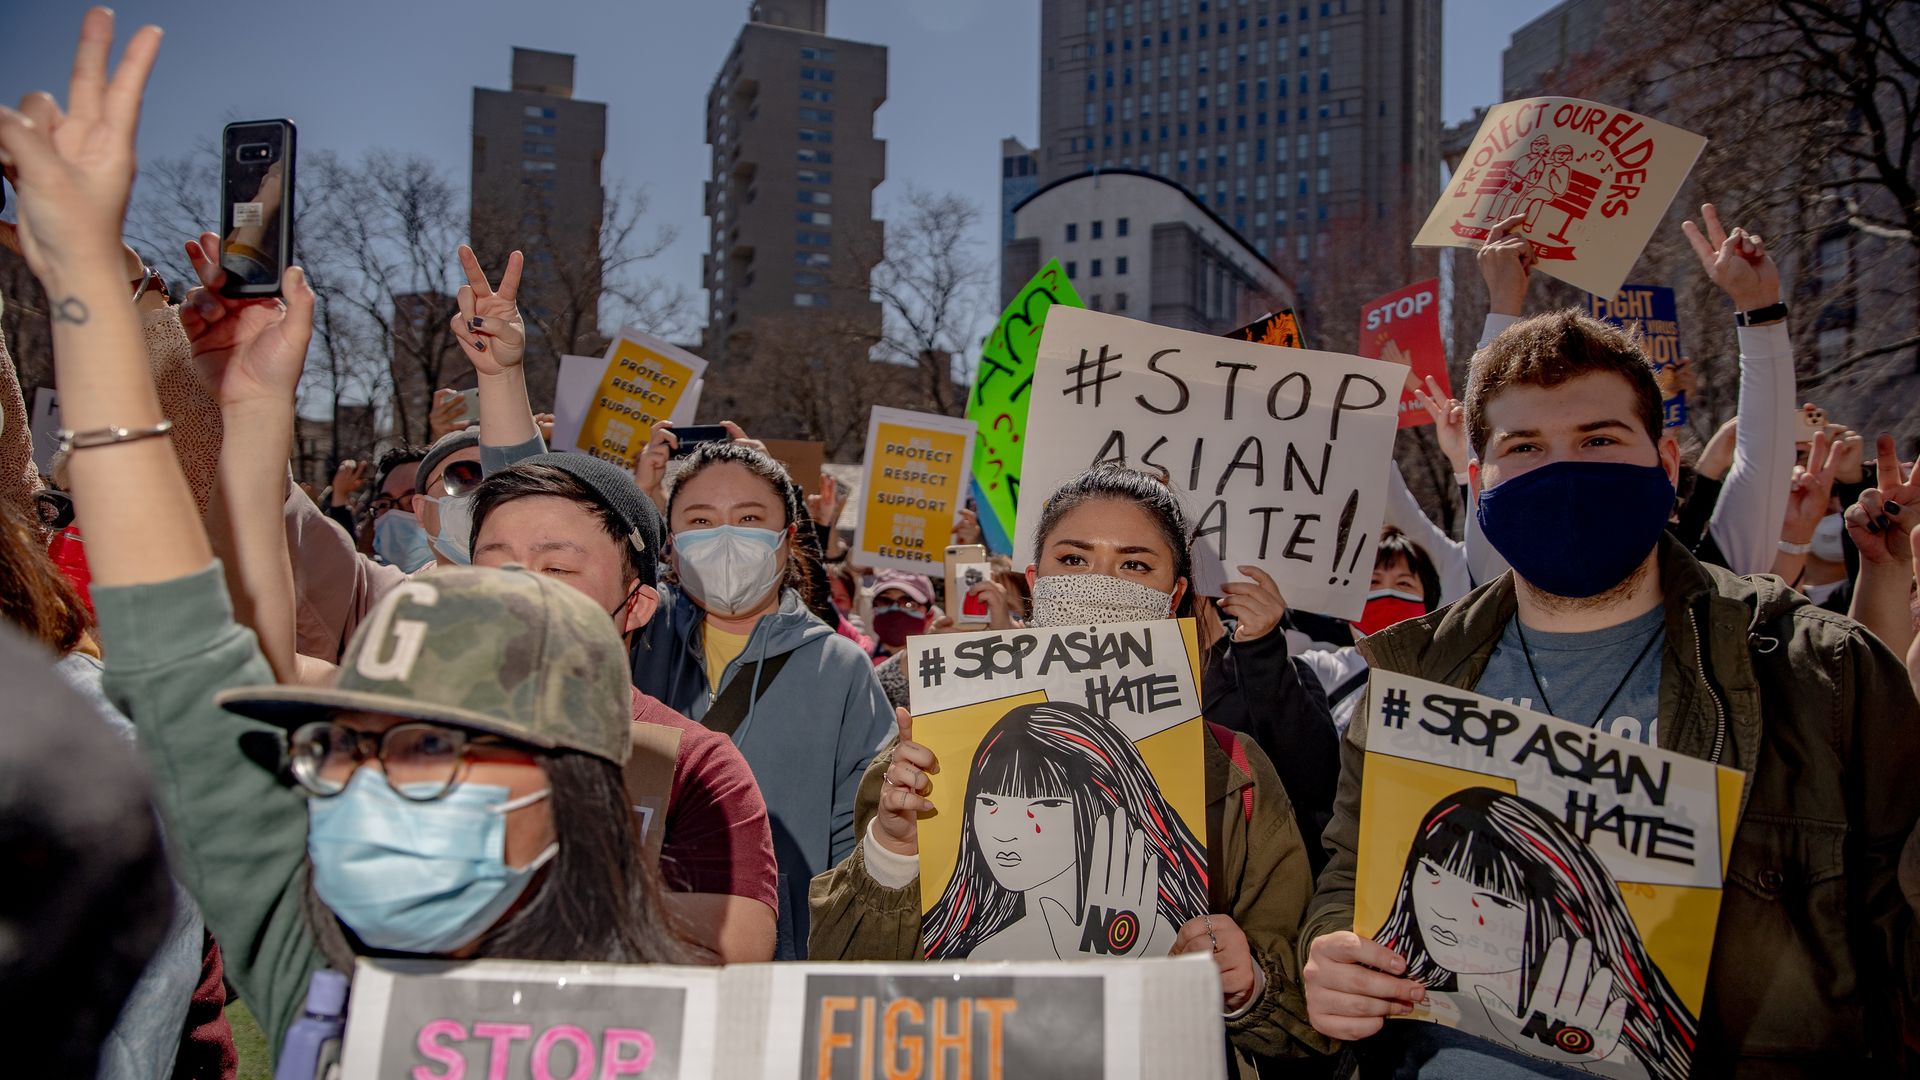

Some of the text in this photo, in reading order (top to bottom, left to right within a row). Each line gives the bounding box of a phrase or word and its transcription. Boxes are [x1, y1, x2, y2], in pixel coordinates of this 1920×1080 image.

[1454, 103, 1655, 219] PROTECT OUR ELDERS
[1365, 291, 1434, 332] STOP
[1591, 290, 1654, 320] FIGHT
[619, 358, 678, 390] PROTECT
[611, 377, 666, 406] RESPECT
[600, 397, 659, 428] SUPPORT
[602, 438, 629, 454] OUR
[885, 443, 953, 465] PROTECT
[884, 467, 948, 487] RESPECT
[1090, 430, 1333, 497] ASIAN
[877, 492, 947, 513] SUPPORT
[892, 535, 925, 549] OUR
[1187, 489, 1368, 587] ATE!!
[879, 546, 933, 564] ELDERS
[357, 580, 439, 682] G
[1085, 673, 1182, 721] HATE
[1565, 789, 1696, 867] HATE
[410, 1017, 656, 1080] STOP
[816, 996, 1018, 1080] FIGHT
